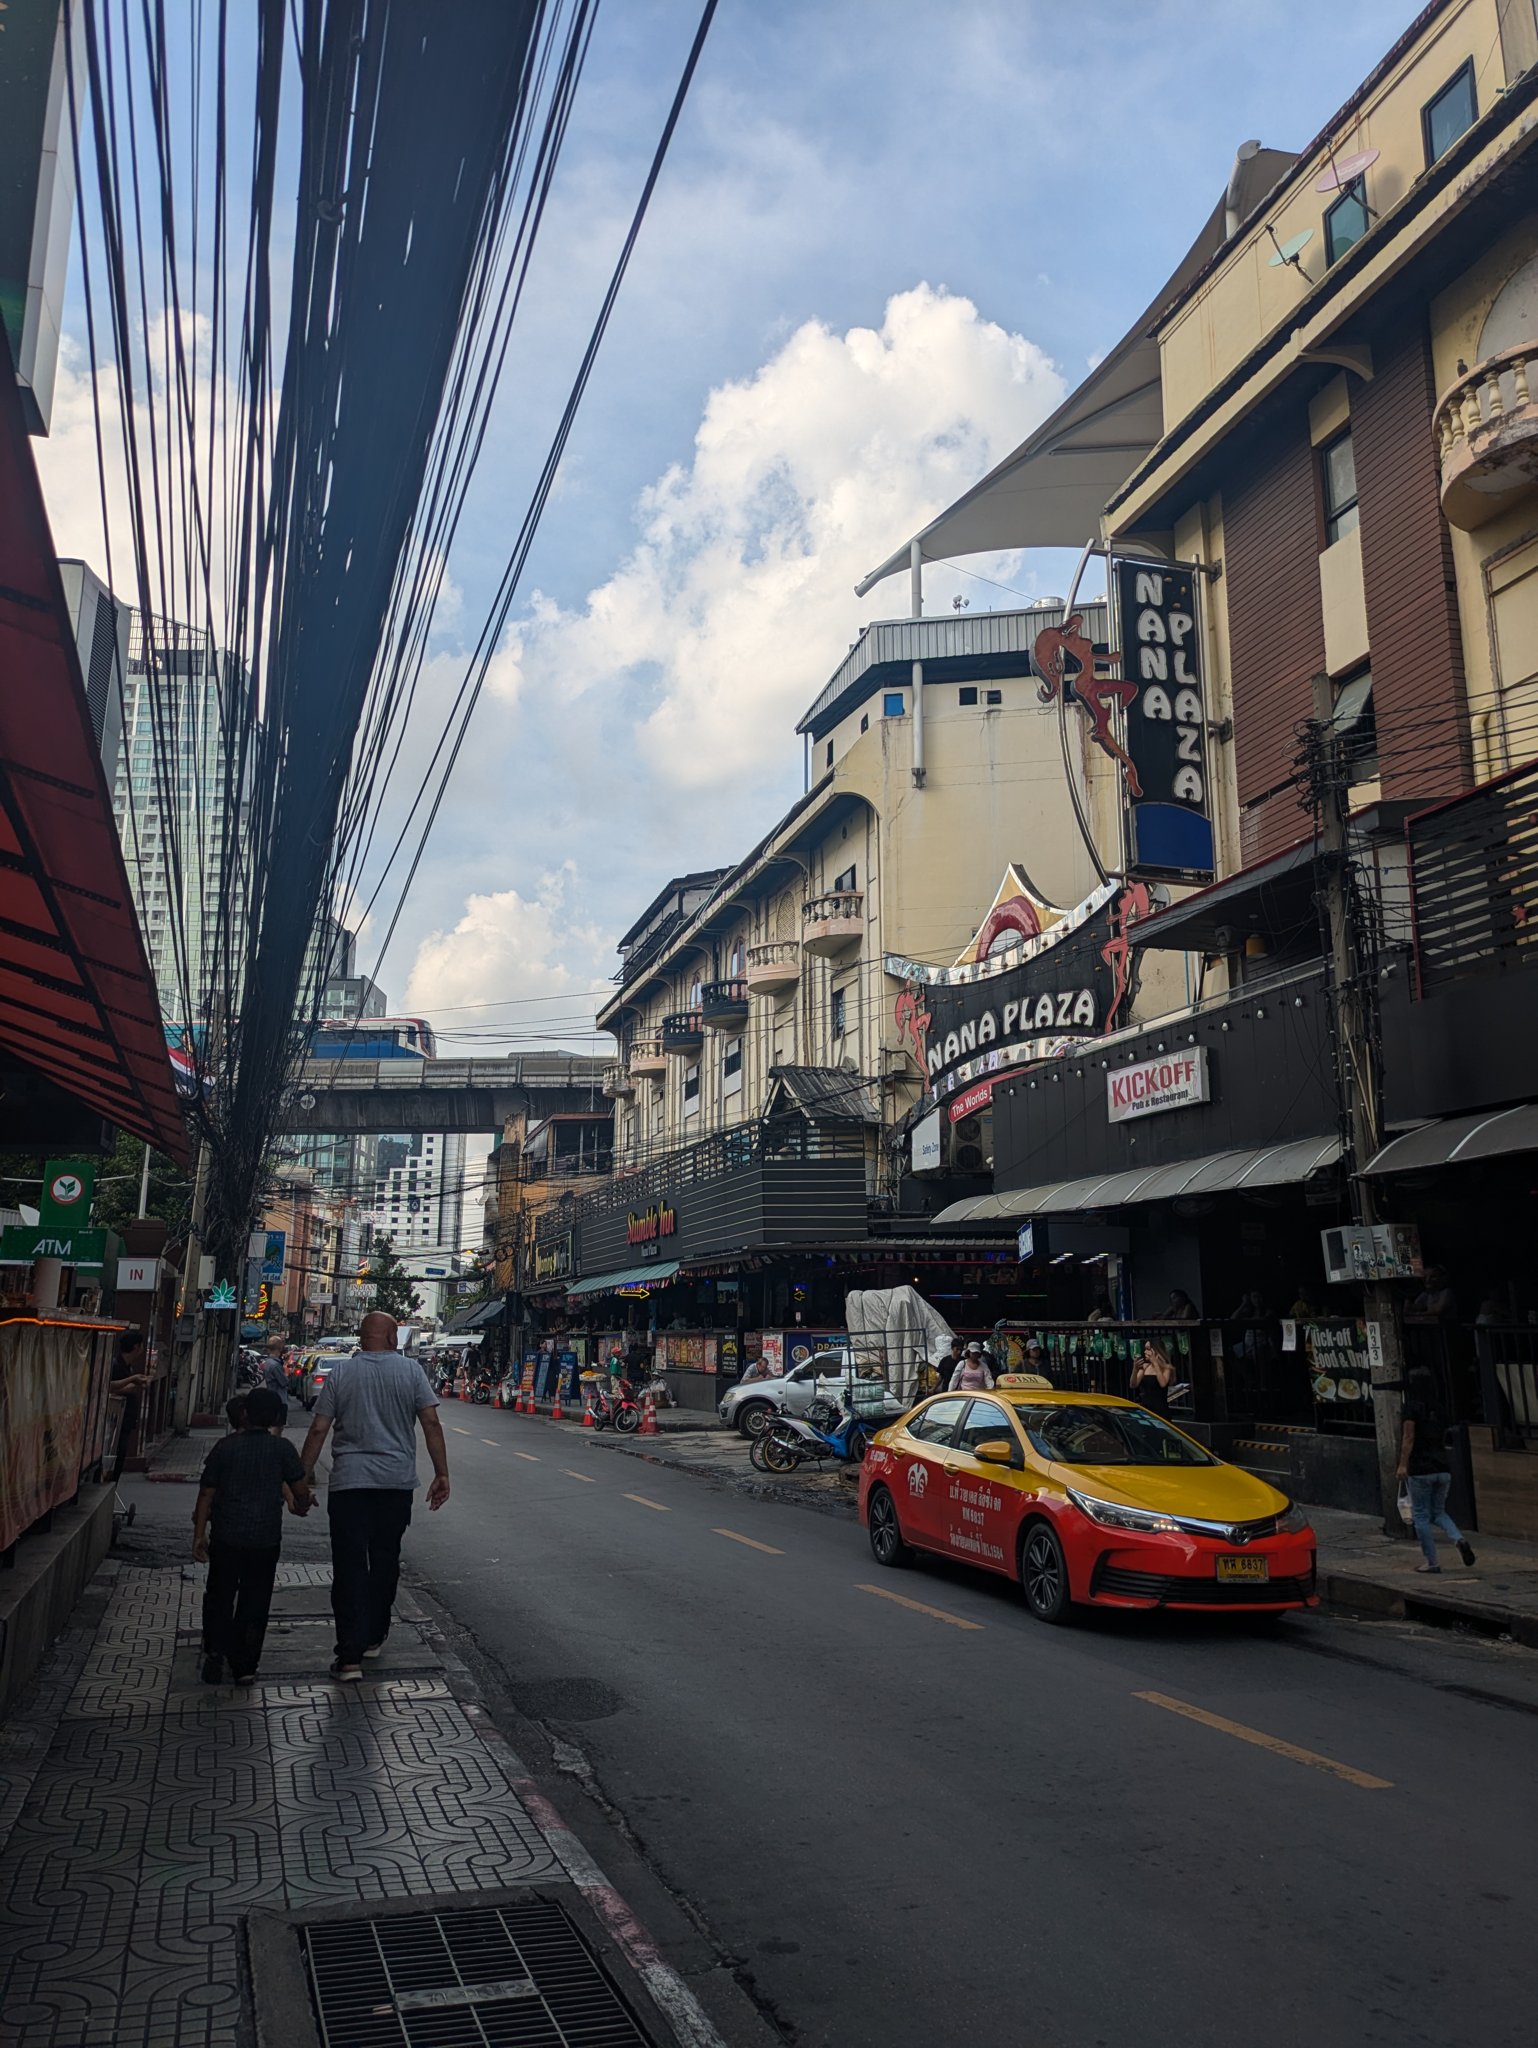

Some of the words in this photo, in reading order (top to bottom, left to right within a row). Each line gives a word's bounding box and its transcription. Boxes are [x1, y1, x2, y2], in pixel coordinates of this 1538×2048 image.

[1136, 571, 1172, 721] NANA
[1168, 611, 1203, 803] PLAZA
[927, 1010, 997, 1076] NANA
[1003, 988, 1096, 1036] PLAZA
[1112, 1061, 1195, 1107] KICKOFF
[952, 1103, 965, 1117] The
[965, 1089, 988, 1109] Worlds
[1132, 1100, 1144, 1111] Pub
[1145, 1100, 1150, 1108] &
[1151, 1089, 1188, 1107] Restaurant
[625, 1206, 657, 1246] Stumble
[32, 1239, 72, 1255] ATM
[129, 1269, 144, 1281] IN
[1311, 1327, 1353, 1347] Kick-off
[1371, 1336, 1377, 1346] 3
[1313, 1350, 1339, 1368] Food
[1339, 1352, 1348, 1368] &
[1373, 1350, 1379, 1361] 3
[1241, 1558, 1263, 1570] 6837
